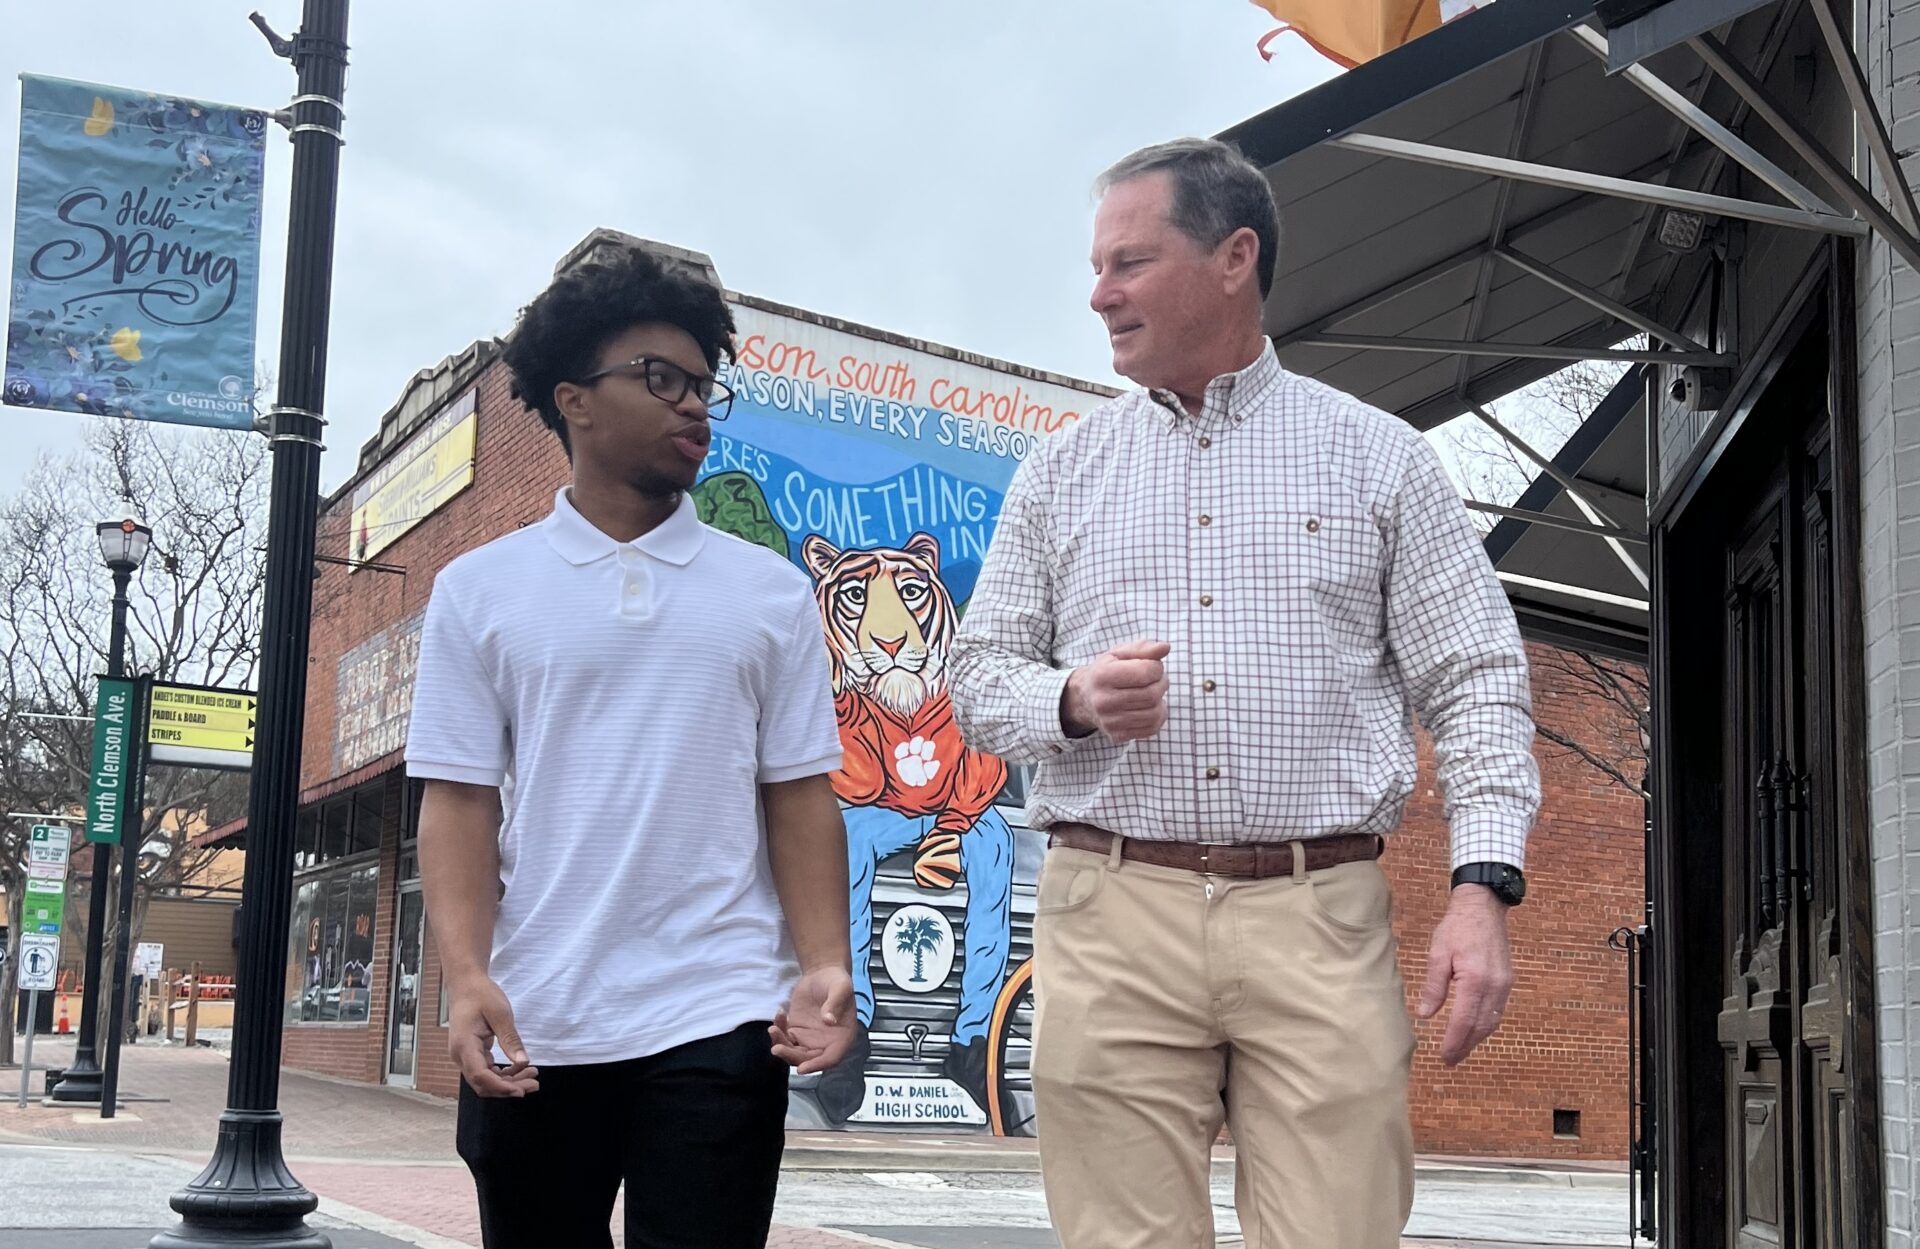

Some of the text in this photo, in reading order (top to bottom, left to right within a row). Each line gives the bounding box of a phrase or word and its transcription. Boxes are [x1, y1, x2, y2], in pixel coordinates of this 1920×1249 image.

[116, 186, 184, 230] Hello
[30, 190, 238, 326] Spring
[738, 334, 832, 386] son,
[837, 355, 916, 402] south
[167, 391, 250, 412] Clemson
[715, 361, 824, 424] EASON,
[829, 387, 928, 442] EVERY
[699, 435, 772, 483] ERE'S
[774, 467, 987, 548] SOMETHING
[152, 709, 207, 724] PADDLE & BOARD
[174, 693, 195, 705] CUSTOM
[217, 697, 225, 708] ICE
[226, 698, 242, 709] CREAM
[151, 728, 182, 741] STRIPES
[93, 691, 126, 834] North Clemson Ave.
[36, 828, 45, 839] 2
[875, 1085, 949, 1098] D.W. DANIEL
[875, 1102, 969, 1119] HIGH SCHOOL
